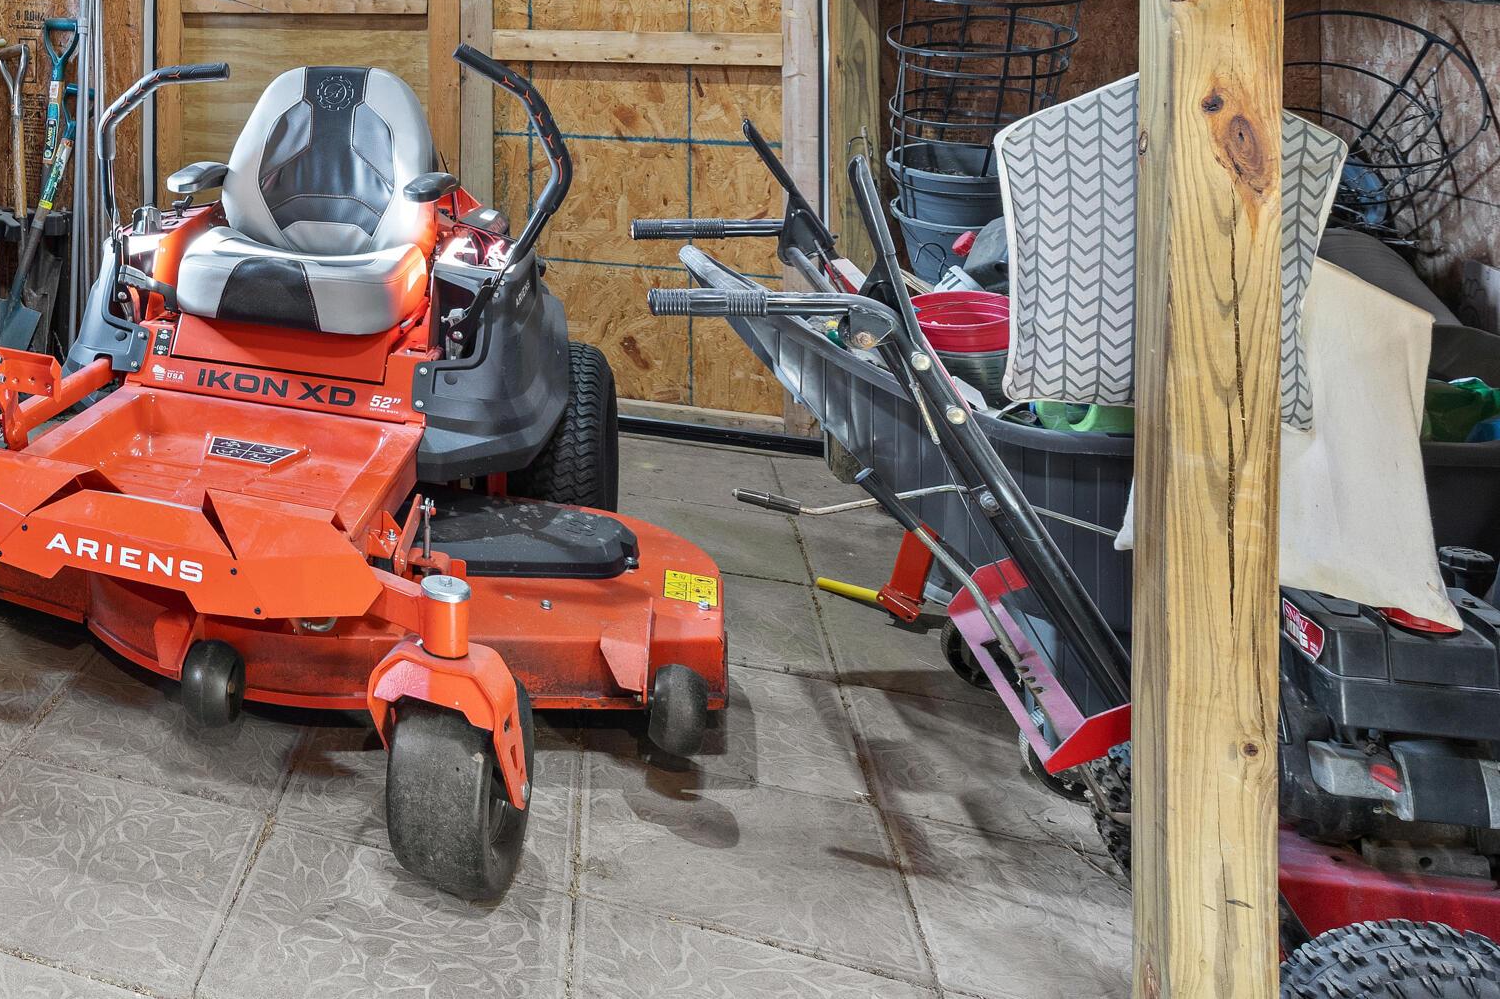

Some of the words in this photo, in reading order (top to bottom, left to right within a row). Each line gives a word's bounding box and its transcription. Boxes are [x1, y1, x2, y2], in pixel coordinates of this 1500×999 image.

[167, 371, 184, 381] USA
[197, 368, 289, 398] IKON
[296, 381, 357, 407] XD
[45, 532, 203, 583] ARIENS
